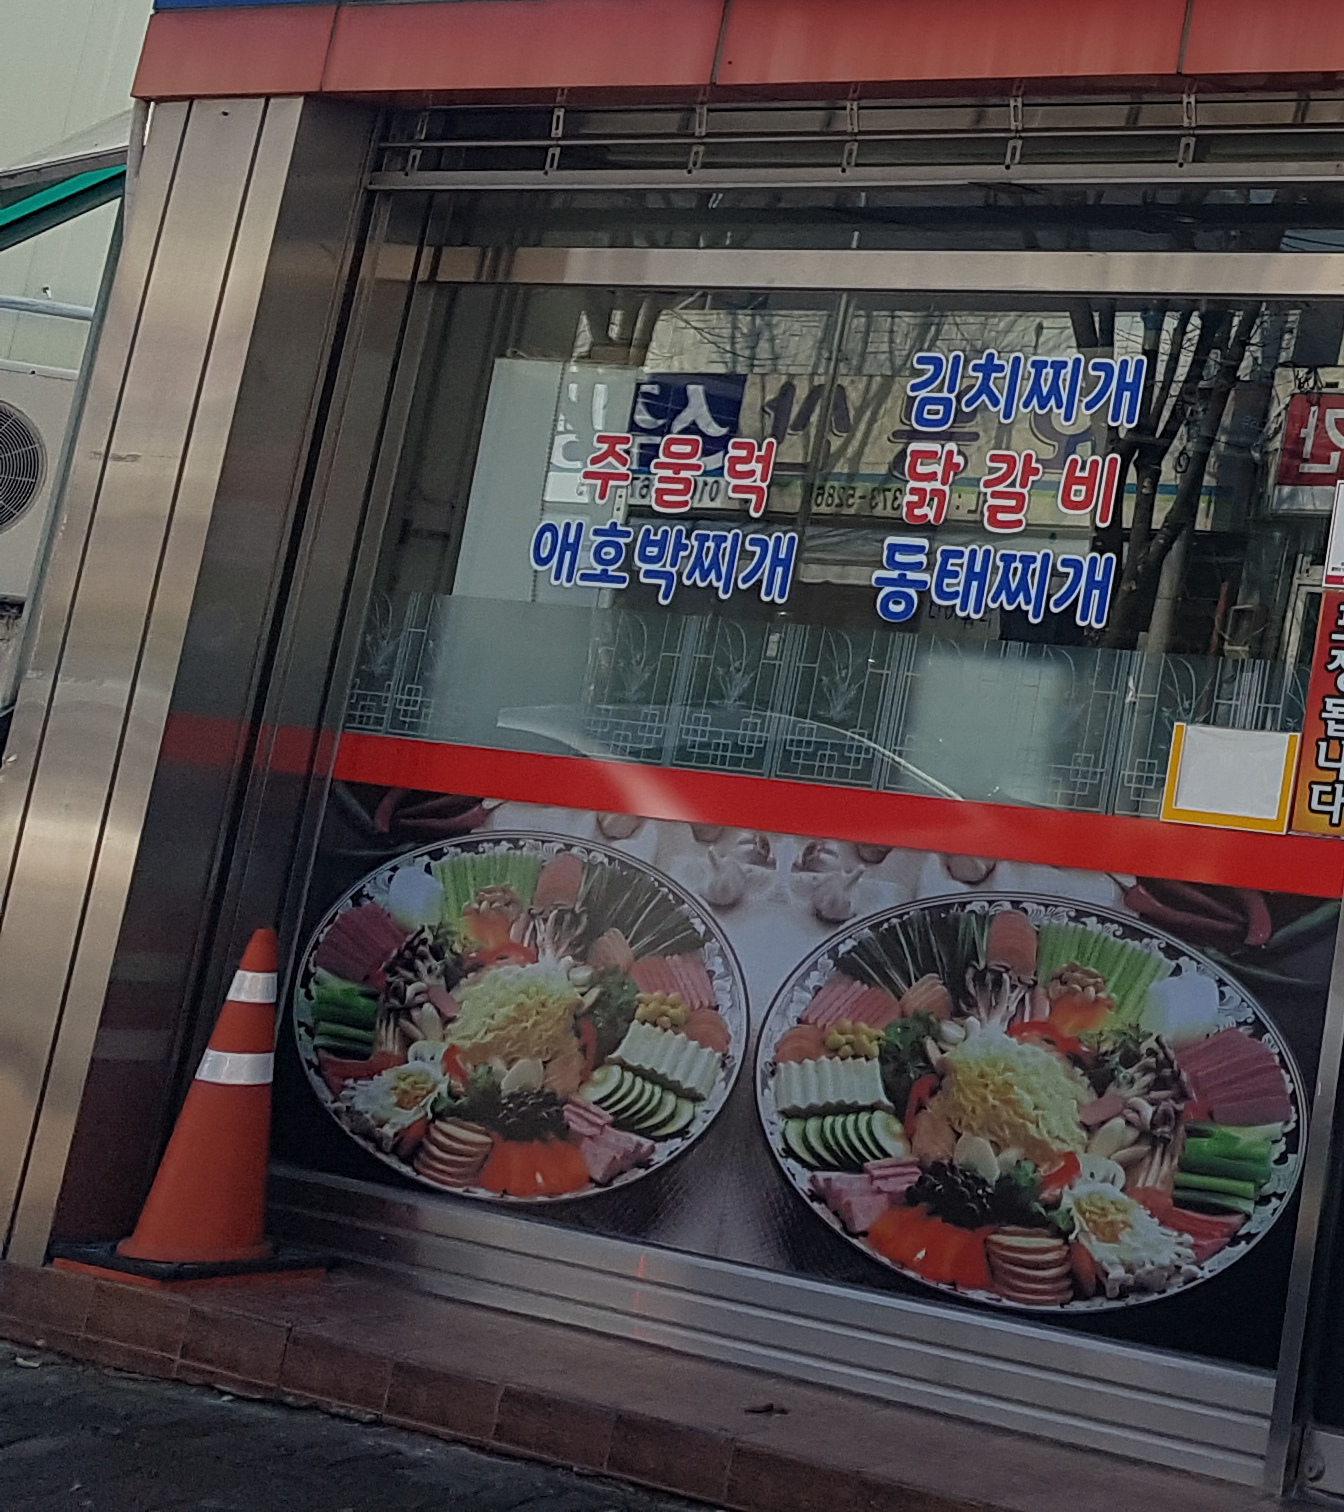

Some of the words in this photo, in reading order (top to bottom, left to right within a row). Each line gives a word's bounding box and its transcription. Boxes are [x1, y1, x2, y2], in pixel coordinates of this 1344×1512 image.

[906, 349, 1147, 430] 김치찌개
[581, 432, 776, 518] 주물럭
[902, 441, 1121, 533] 닭갈비
[530, 519, 798, 605] 애호박찌개
[872, 535, 1116, 628] 동태찌개
